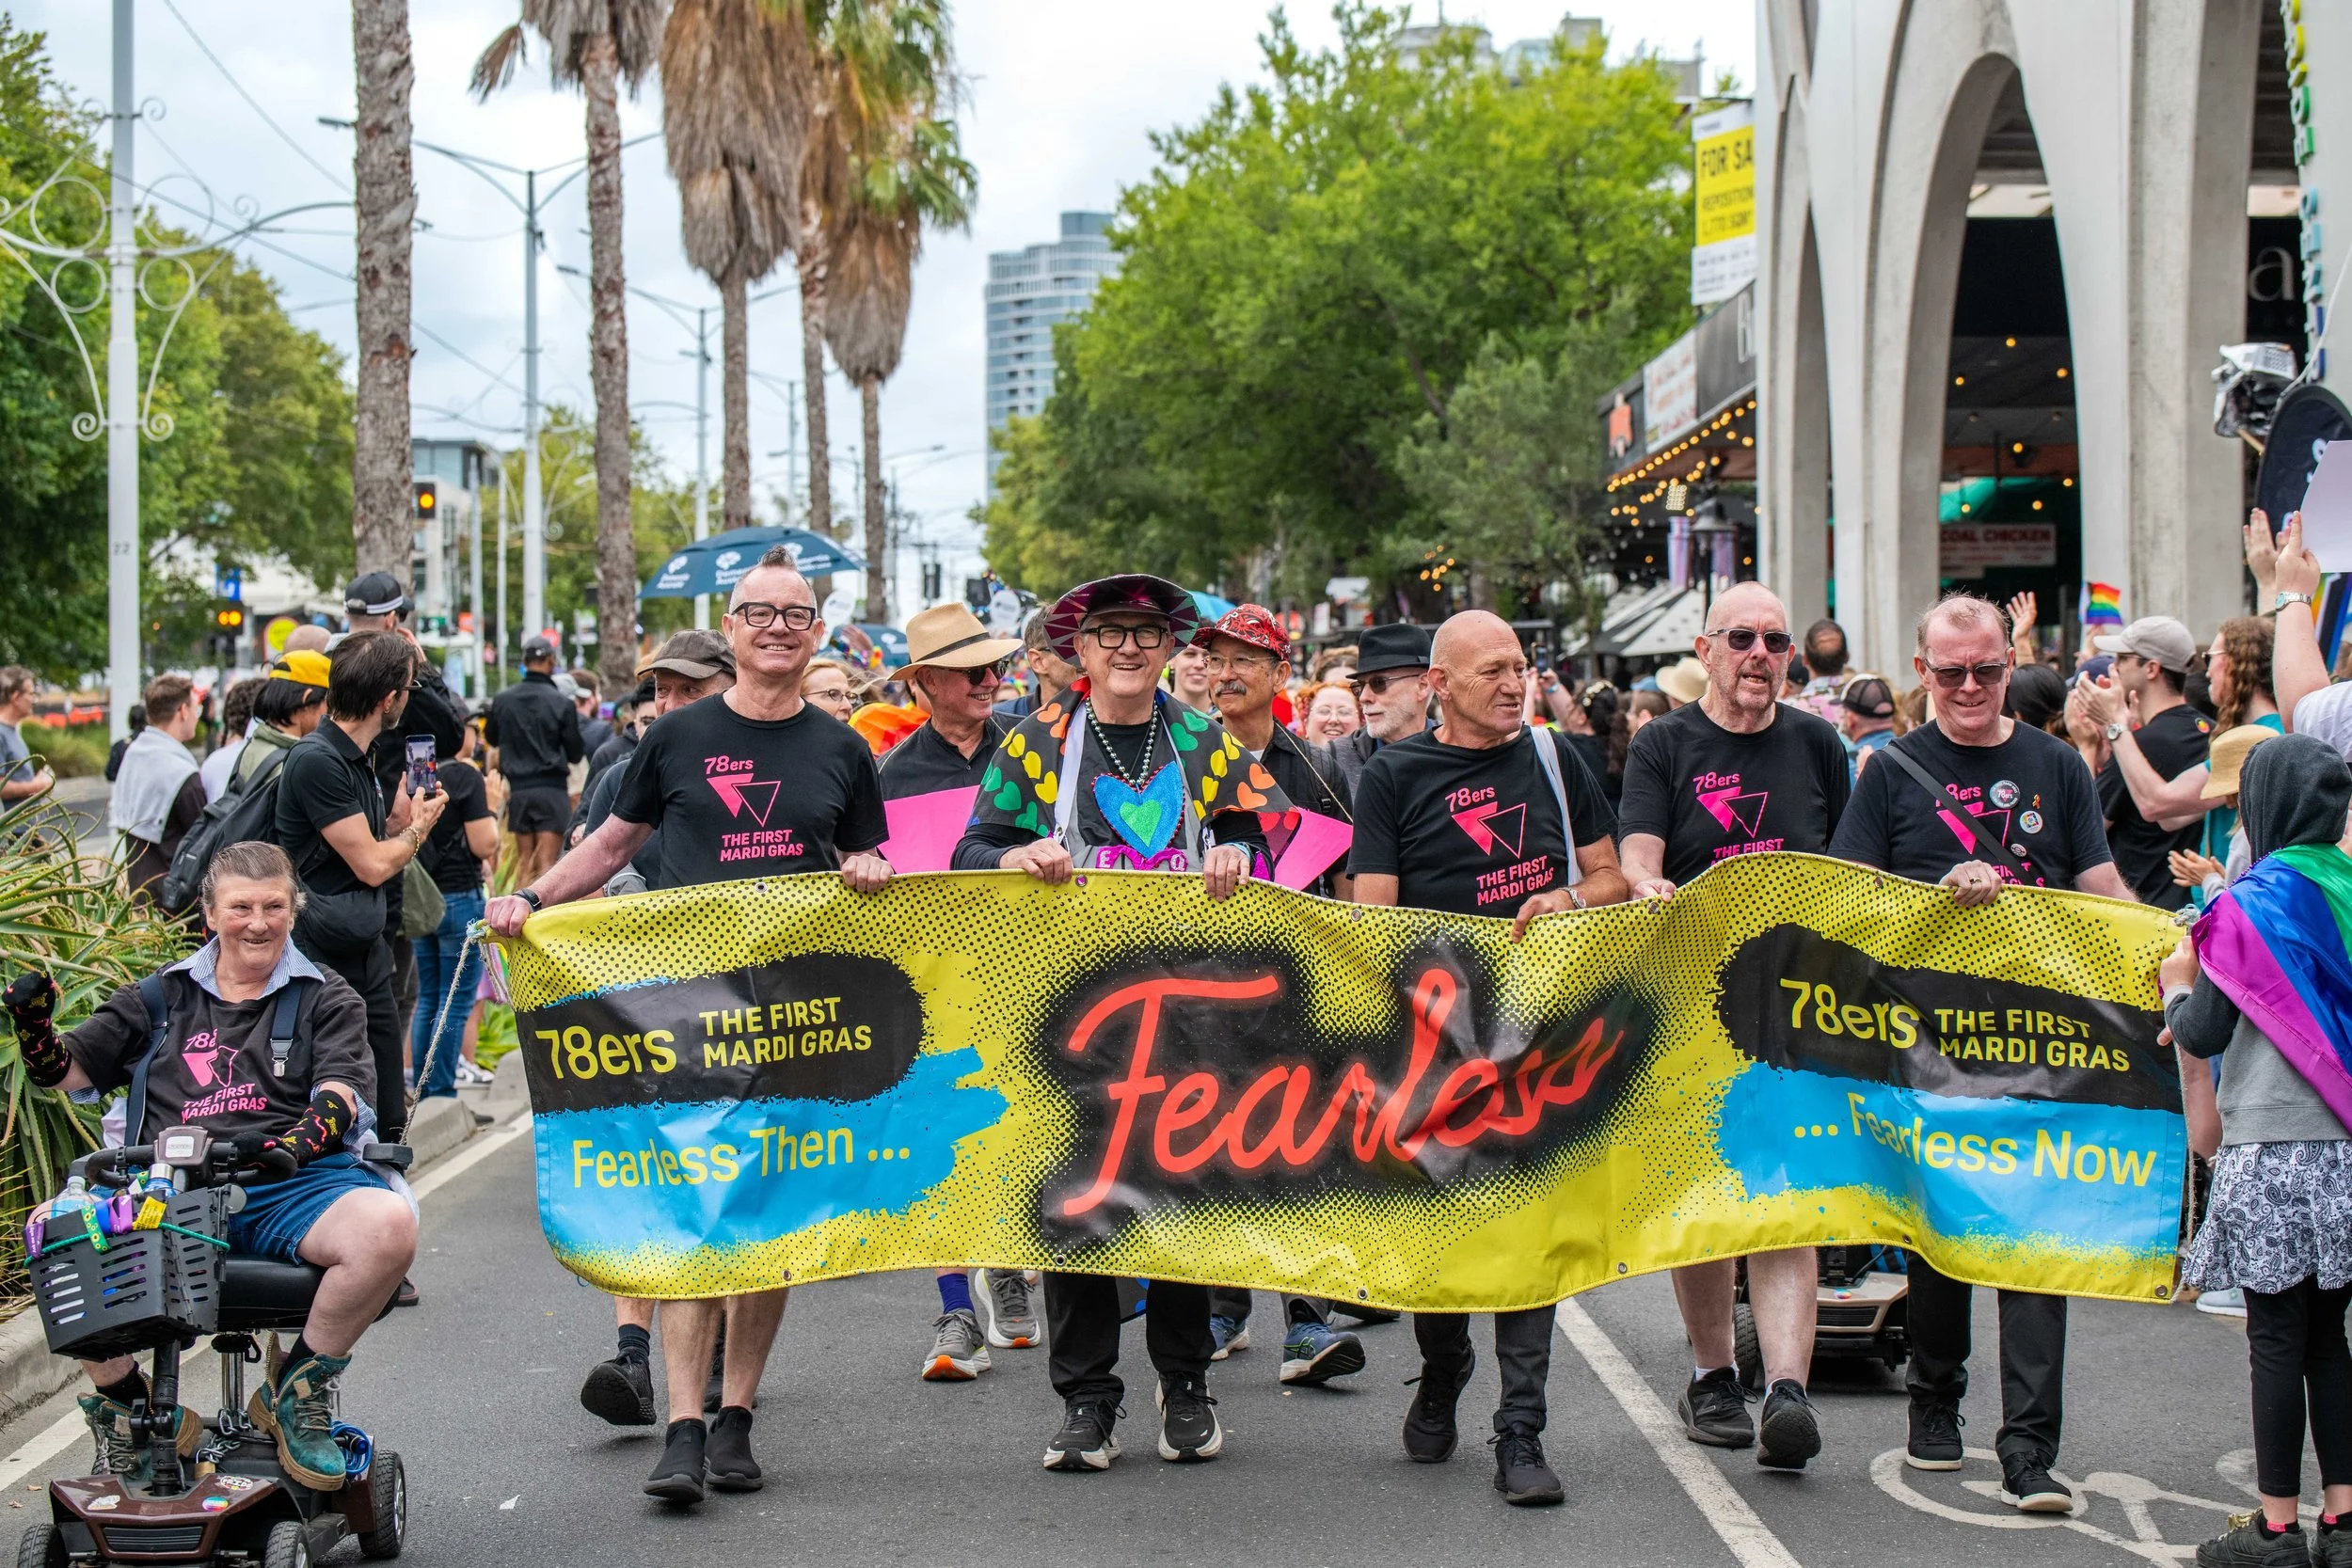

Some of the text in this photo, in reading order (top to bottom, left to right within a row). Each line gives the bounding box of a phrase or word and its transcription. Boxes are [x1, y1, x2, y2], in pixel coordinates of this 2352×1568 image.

[1700, 146, 1728, 180] FOR
[705, 754, 755, 775] 78ers
[1693, 771, 1740, 794] 78ers
[1935, 783, 1982, 808] 8ers
[1444, 786, 1496, 814] 78ers
[720, 843, 804, 862] MARDI GRAS
[722, 829, 793, 847] THE FIRST
[1713, 838, 1785, 859] THE FIRST
[1476, 855, 1549, 890] THE FIRST
[1476, 866, 1555, 907] MARDI GRAS
[699, 996, 842, 1037] THE FIRST
[1780, 977, 1921, 1050] 78ers
[1934, 1007, 2090, 1039] THE FIRST
[535, 1024, 677, 1080] 78ers
[703, 1024, 873, 1069] MARDI GRAS
[1938, 1036, 2131, 1072] MARDI GRAS
[183, 1083, 255, 1108] THE FIRST
[1063, 967, 1625, 1217] Fearless
[181, 1097, 268, 1124] MARDI GRAS
[1847, 1092, 2018, 1177] Fearless
[2032, 1129, 2157, 1187] Now
[573, 1137, 739, 1189] Fearless
[749, 1126, 854, 1178] Then
